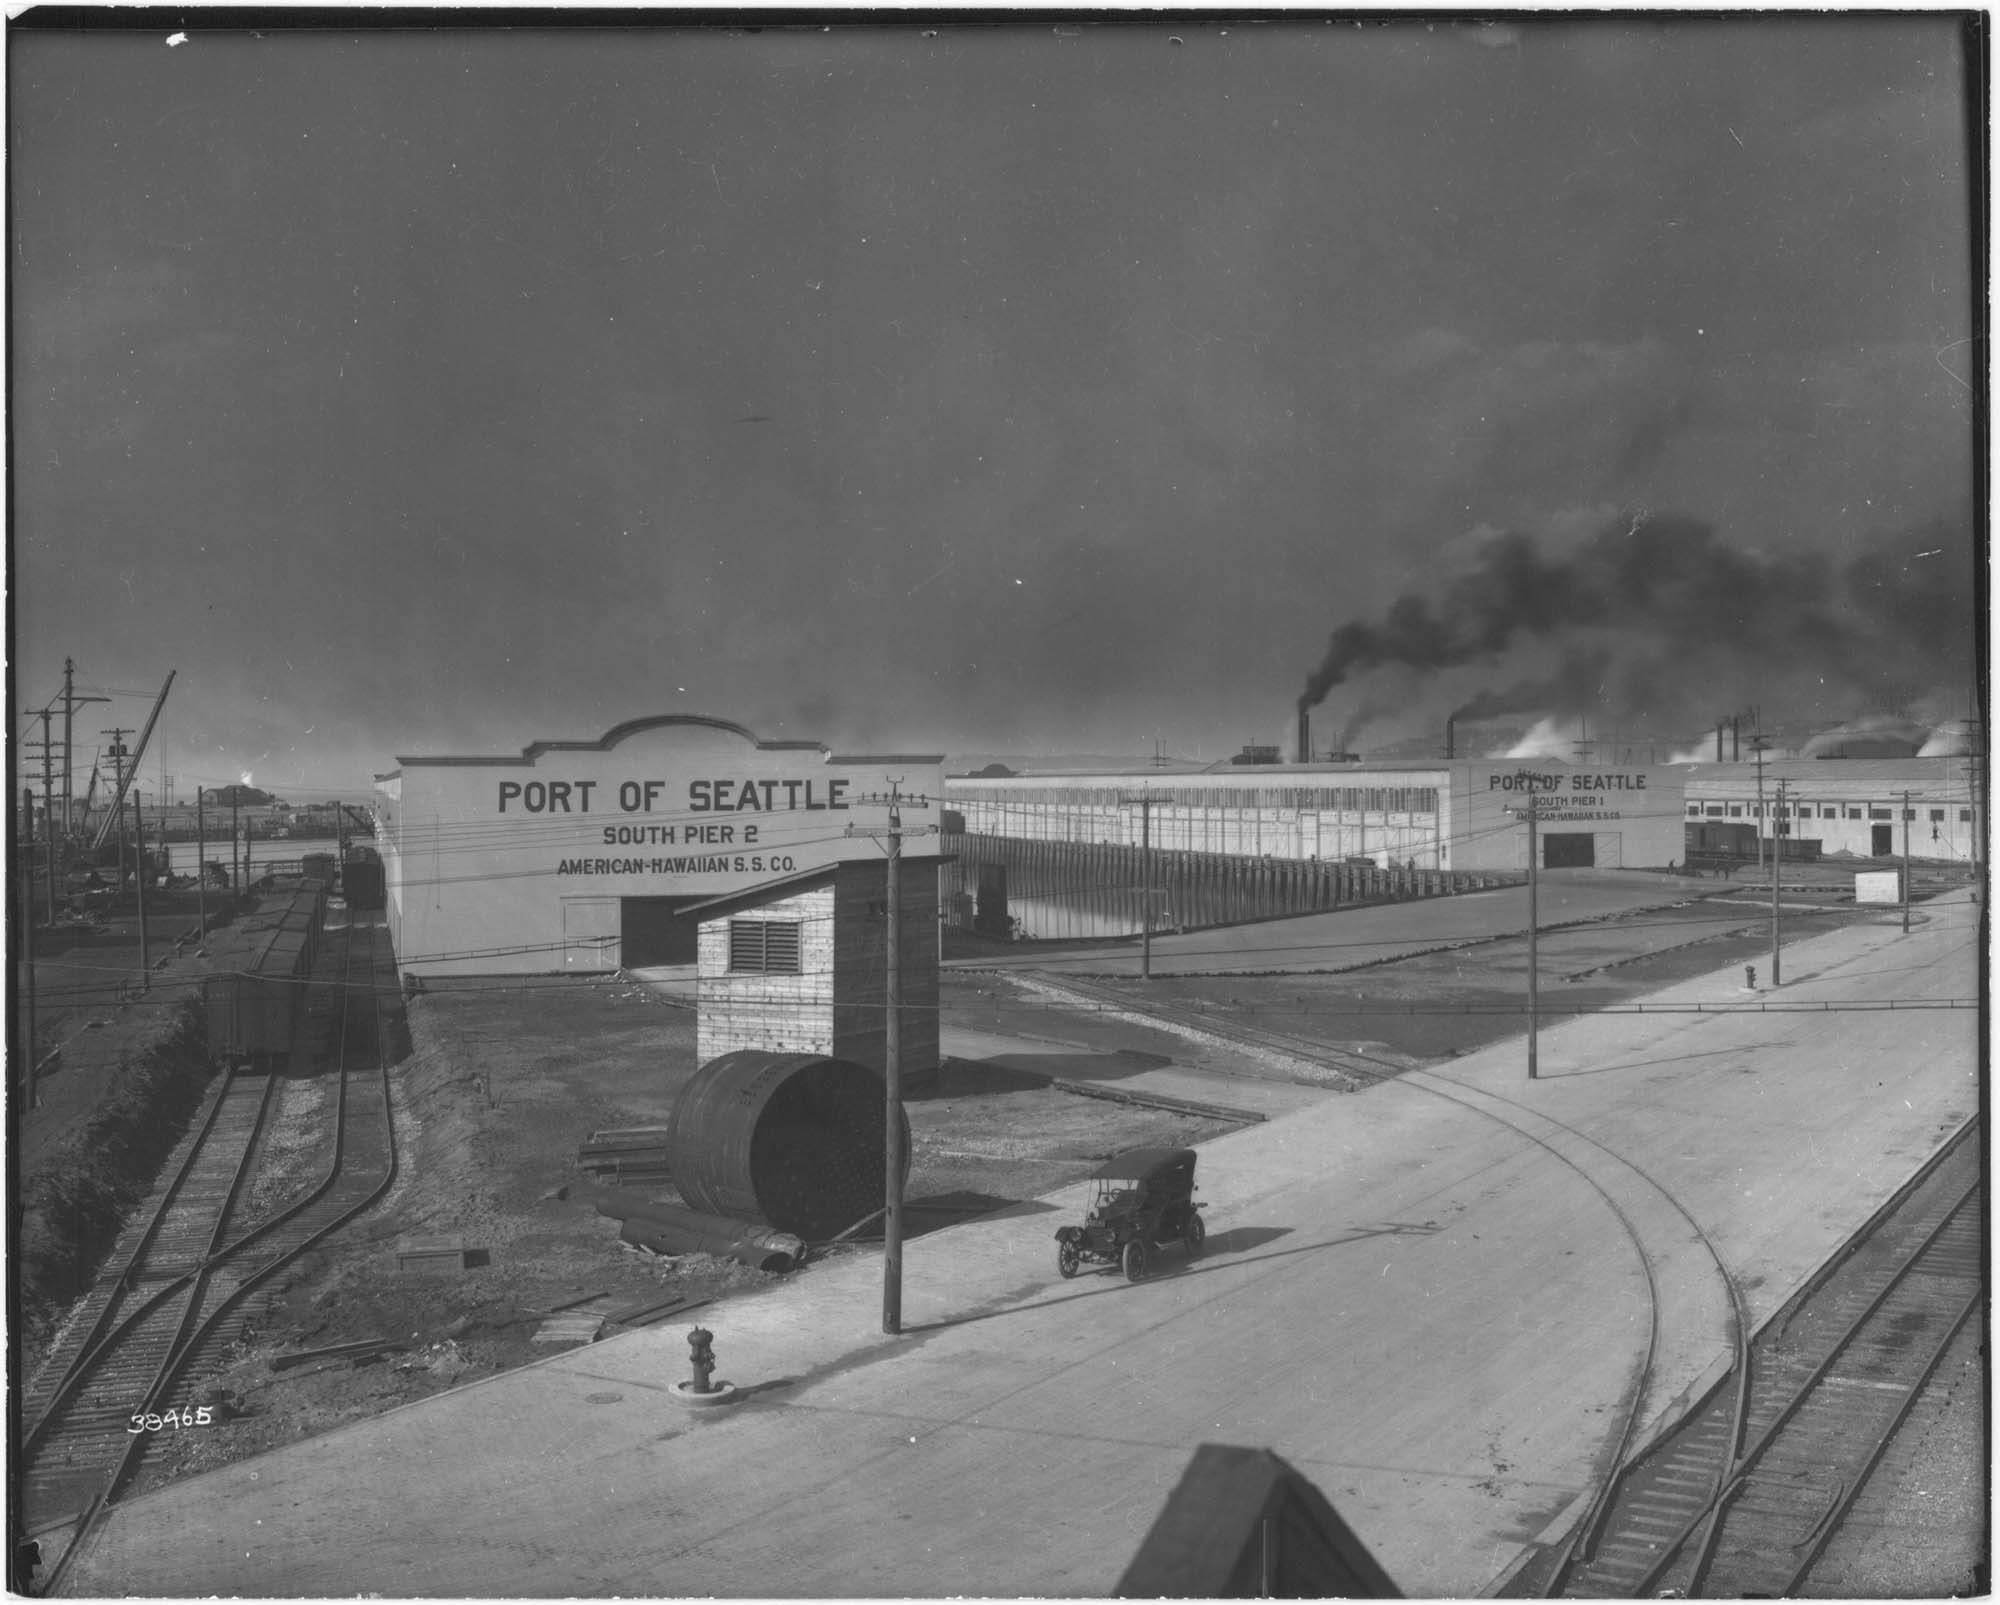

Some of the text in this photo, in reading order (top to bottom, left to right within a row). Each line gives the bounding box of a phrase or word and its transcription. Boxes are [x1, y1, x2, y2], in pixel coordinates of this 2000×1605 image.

[1490, 775, 1647, 790] PORT OF SEATTLE
[499, 779, 851, 813] PORT OF SEATTLE
[1533, 796, 1568, 806] SOUTH
[1571, 796, 1596, 806] PIER
[603, 825, 759, 844] SOUTH PIER 2
[558, 857, 729, 875] AMERICAN-HAWAIIAN
[770, 856, 797, 872] CO.
